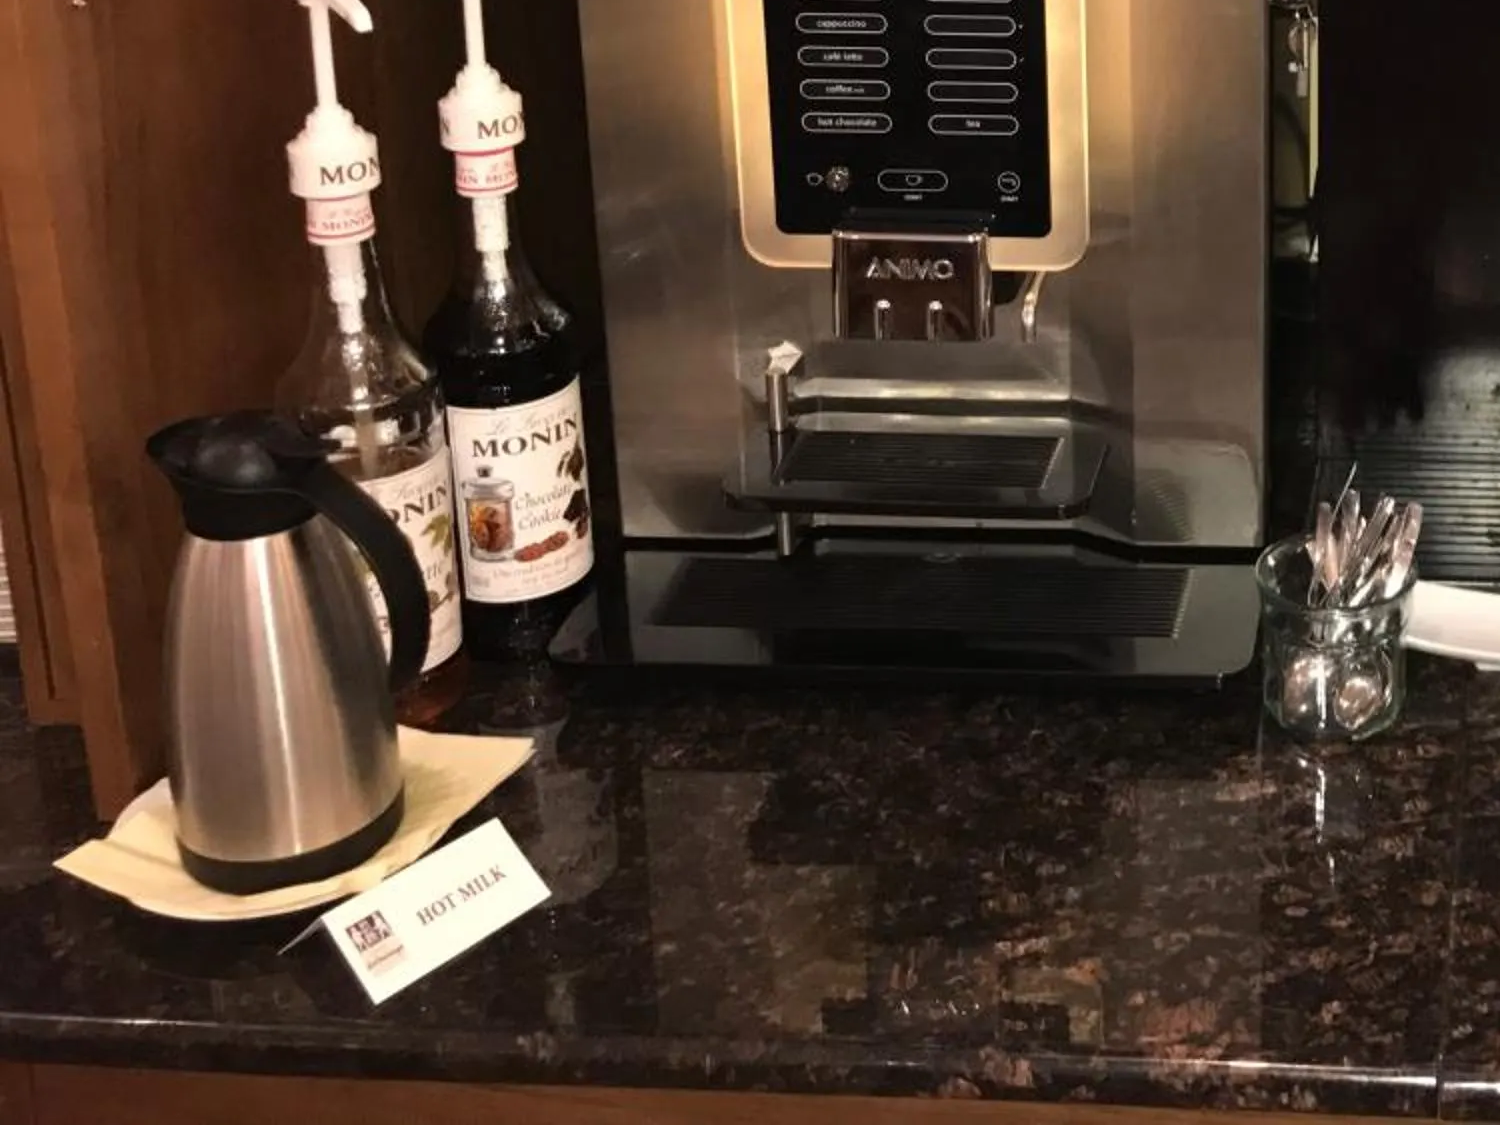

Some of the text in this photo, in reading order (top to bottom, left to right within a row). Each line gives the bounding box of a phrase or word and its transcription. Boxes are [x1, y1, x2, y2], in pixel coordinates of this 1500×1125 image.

[867, 258, 953, 280] ANIMO
[472, 413, 577, 458] MONIN
[416, 864, 507, 926] HOT MILK
